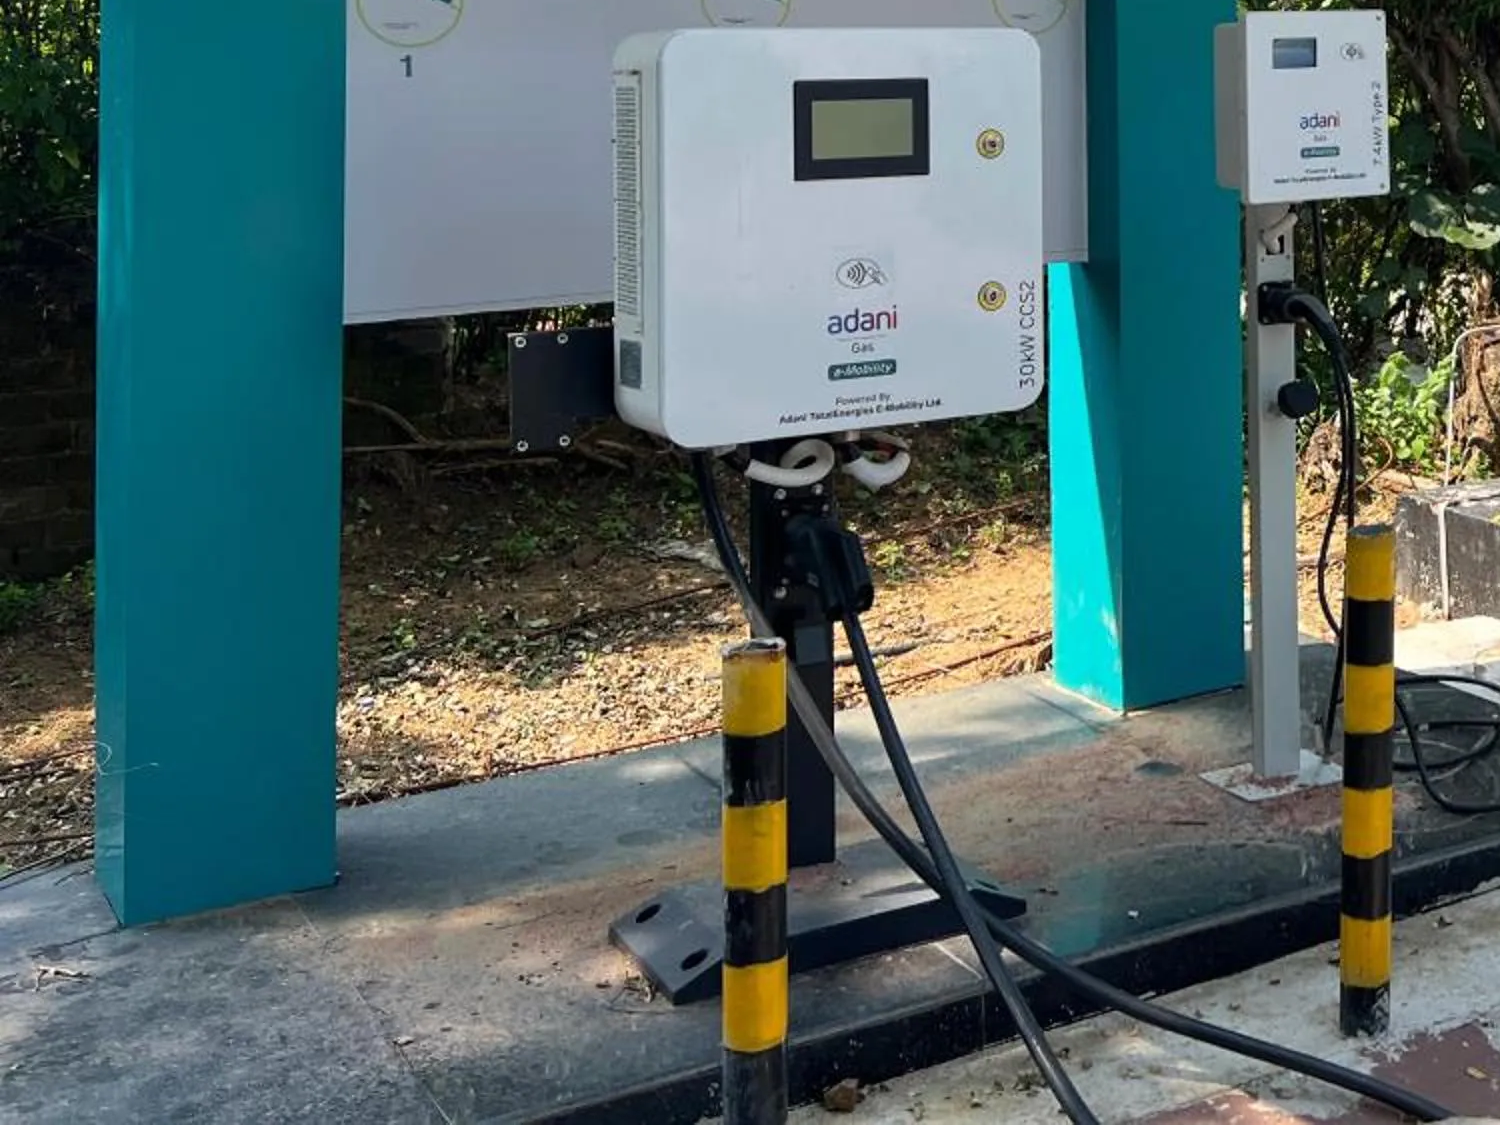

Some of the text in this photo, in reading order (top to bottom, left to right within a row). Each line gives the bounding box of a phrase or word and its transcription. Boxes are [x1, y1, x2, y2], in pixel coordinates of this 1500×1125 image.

[399, 54, 413, 78] 1
[1299, 111, 1341, 130] adani
[1371, 93, 1385, 124] Type
[827, 304, 898, 335] adani
[850, 342, 875, 354] Gas
[1019, 279, 1036, 390] 30kW CCS2
